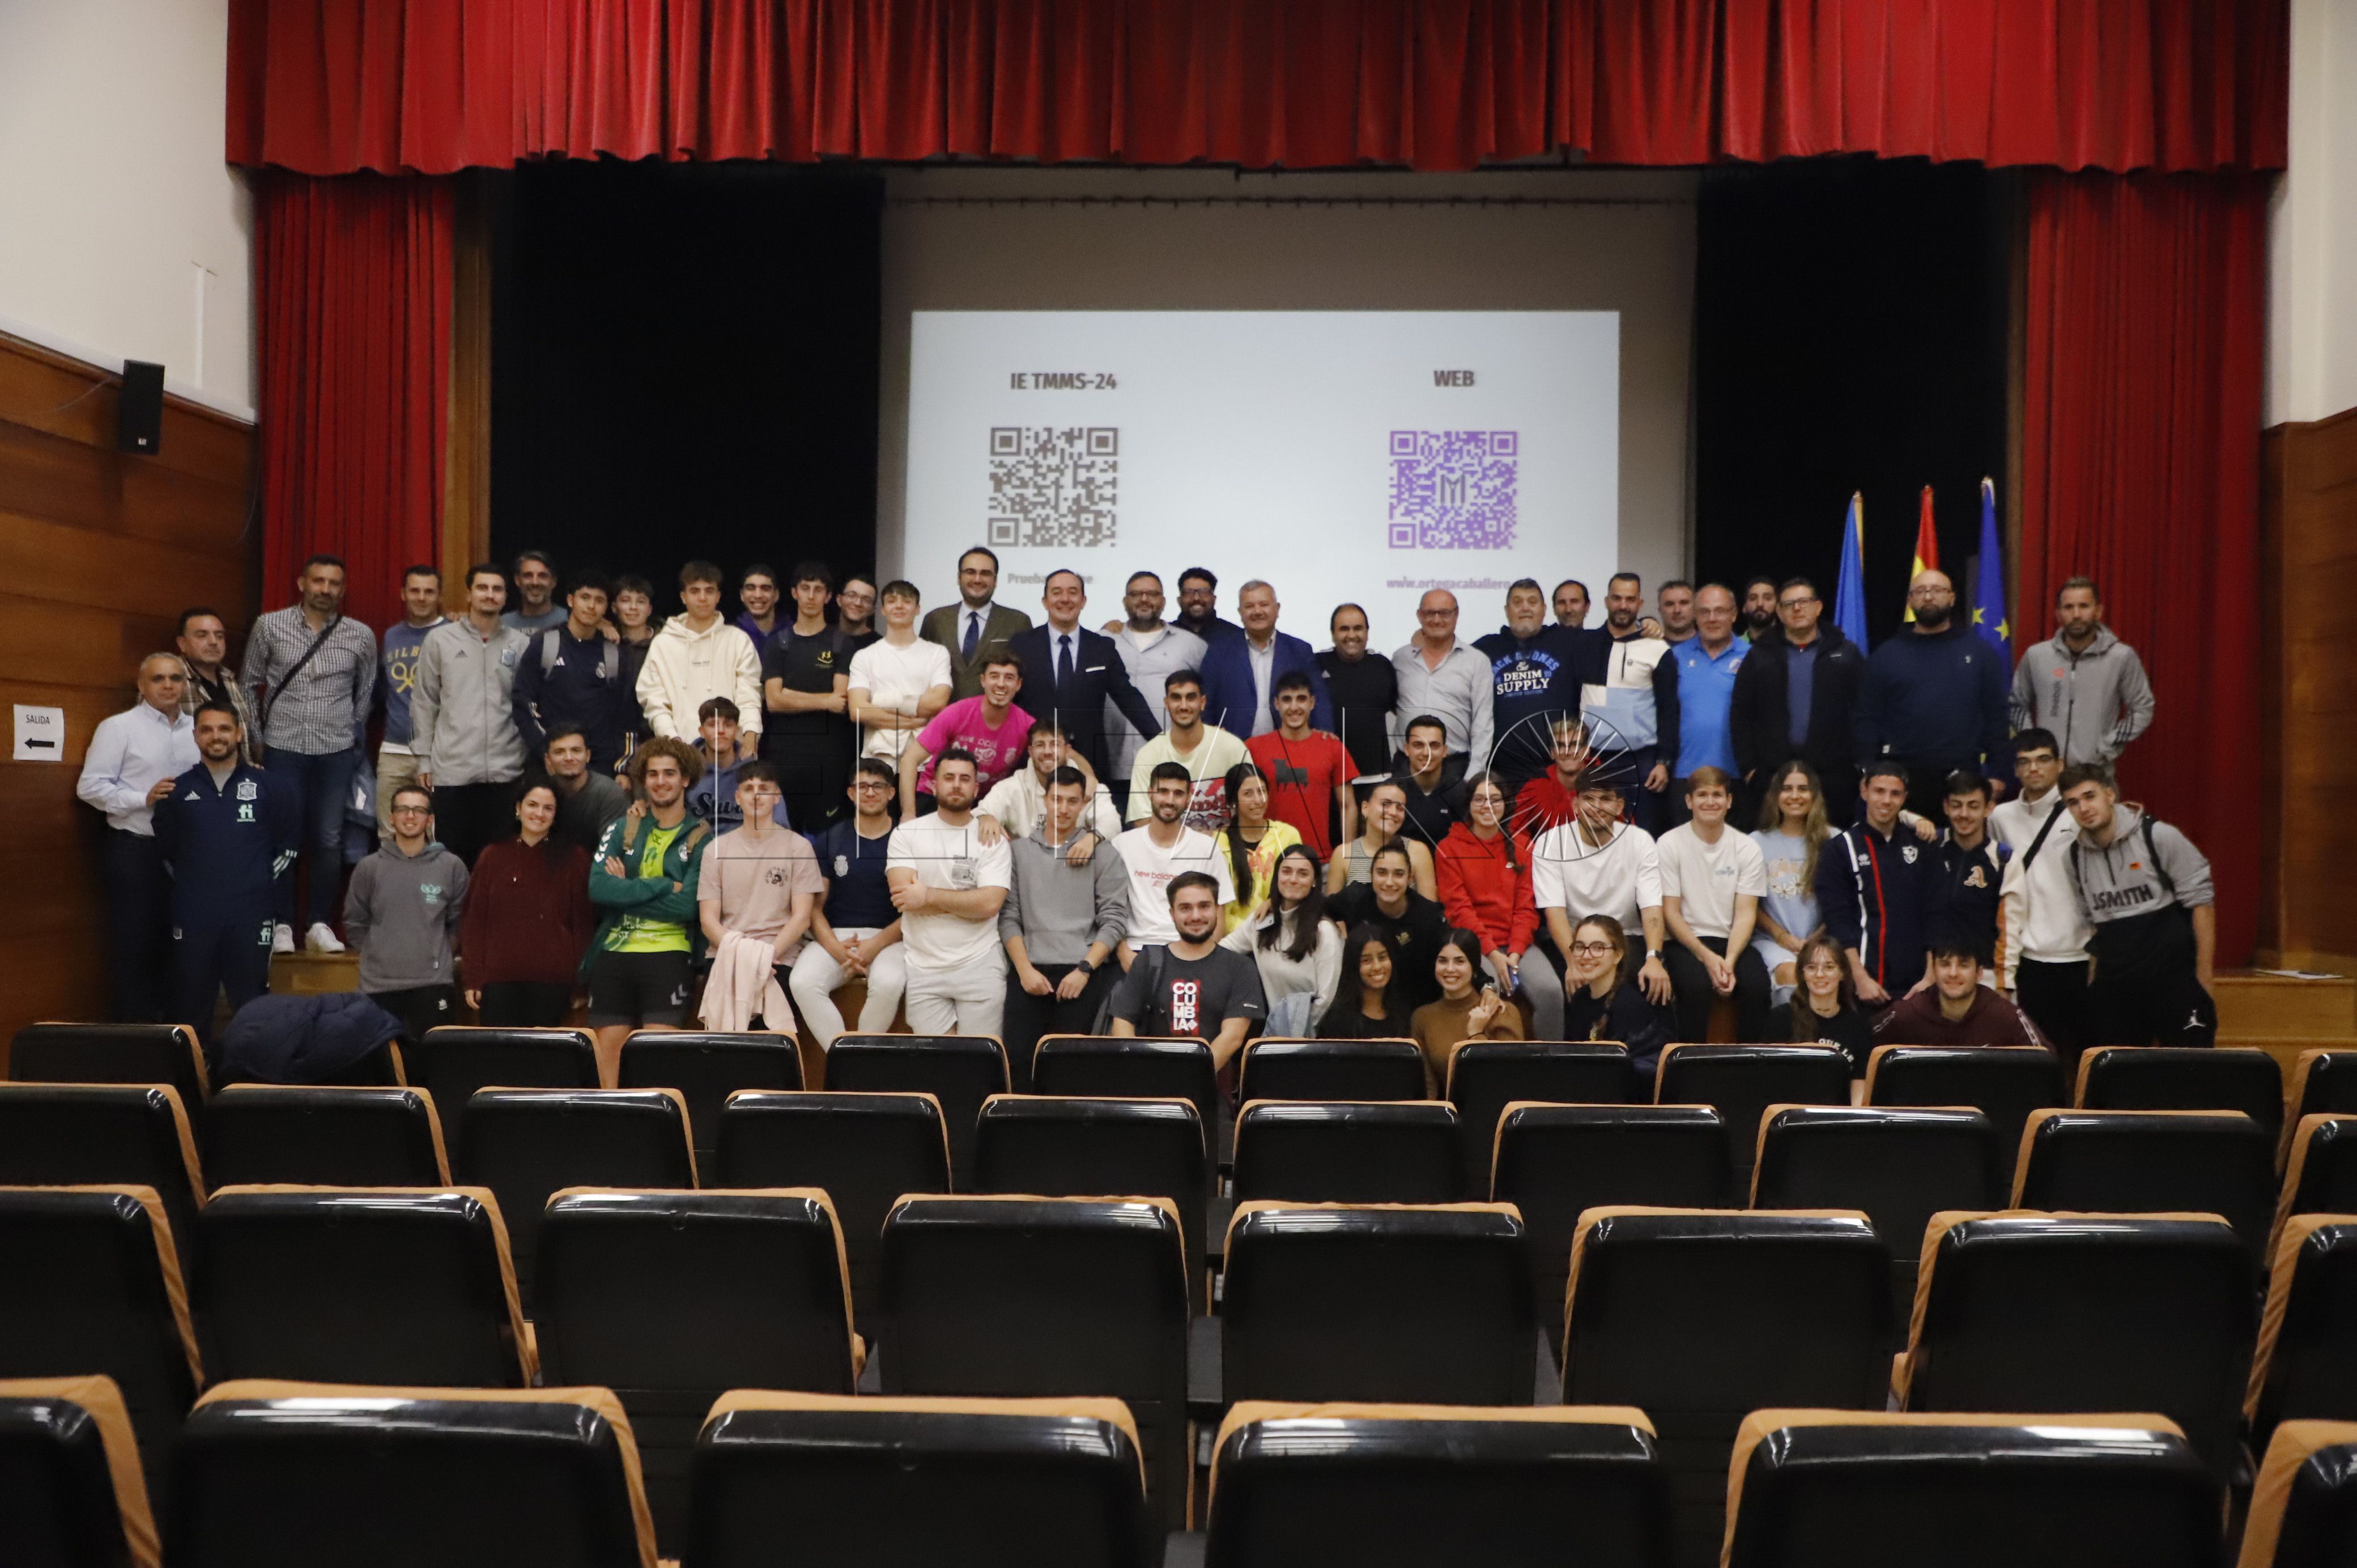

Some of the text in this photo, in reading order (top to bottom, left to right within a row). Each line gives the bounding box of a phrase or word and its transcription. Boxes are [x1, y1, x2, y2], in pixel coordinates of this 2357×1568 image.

[1011, 373, 1117, 390] IE TMMS-24
[1433, 370, 1475, 387] WEB
[1526, 651, 1560, 671] ONES
[1503, 669, 1542, 682] DENIM
[1496, 678, 1550, 696] SUPPLY
[26, 714, 50, 725] SALIDA
